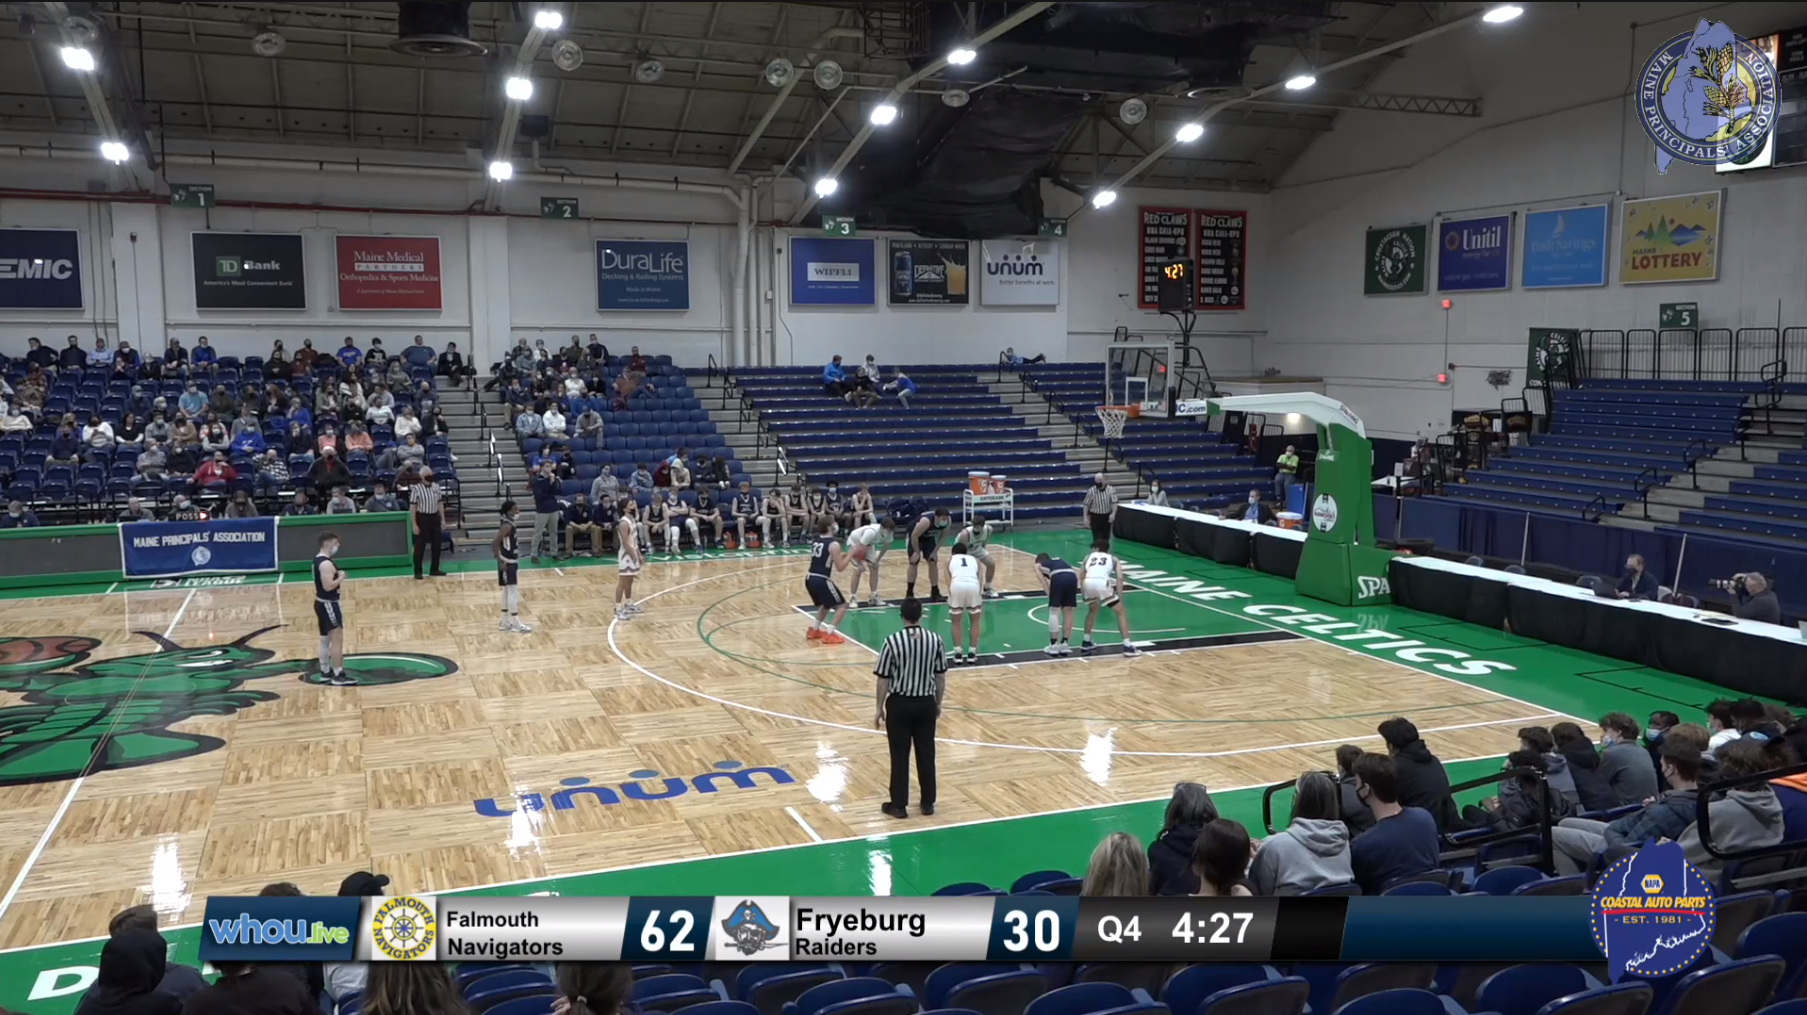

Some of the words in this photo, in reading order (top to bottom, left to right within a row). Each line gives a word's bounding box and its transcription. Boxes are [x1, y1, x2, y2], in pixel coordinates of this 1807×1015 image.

[198, 192, 206, 206] 1
[562, 205, 572, 218] 2
[1144, 211, 1160, 225] RED
[1161, 213, 1188, 226] CLAWS
[1201, 214, 1216, 227] RED
[1217, 216, 1243, 228] CLAWS
[841, 222, 850, 235] 3
[1054, 224, 1063, 236] 4
[1462, 225, 1502, 251] Unitil
[354, 250, 385, 262] Maine
[386, 251, 424, 263] Medical
[1632, 247, 1657, 256] MAINE
[218, 259, 238, 273] TD
[244, 260, 281, 271] Bank
[601, 249, 684, 274] DuraLife
[986, 254, 1044, 276] unum
[1631, 252, 1703, 271] LOTTERY
[388, 274, 409, 284] Sports
[409, 273, 439, 283] Medicine
[601, 273, 629, 282] Decking
[636, 273, 658, 282] Railing
[658, 274, 684, 282] Systems
[813, 267, 852, 277] WIPFLI
[914, 264, 945, 279] DEFINITIVE
[1680, 311, 1691, 326] 5
[175, 512, 199, 521] POSS
[133, 536, 160, 548] MAINE
[213, 531, 266, 543] ASSOCIATION
[811, 542, 824, 558] 33
[960, 557, 968, 567] 1
[1089, 557, 1108, 566] 23
[1242, 603, 1518, 676] CELTICS
[473, 760, 797, 817] unum
